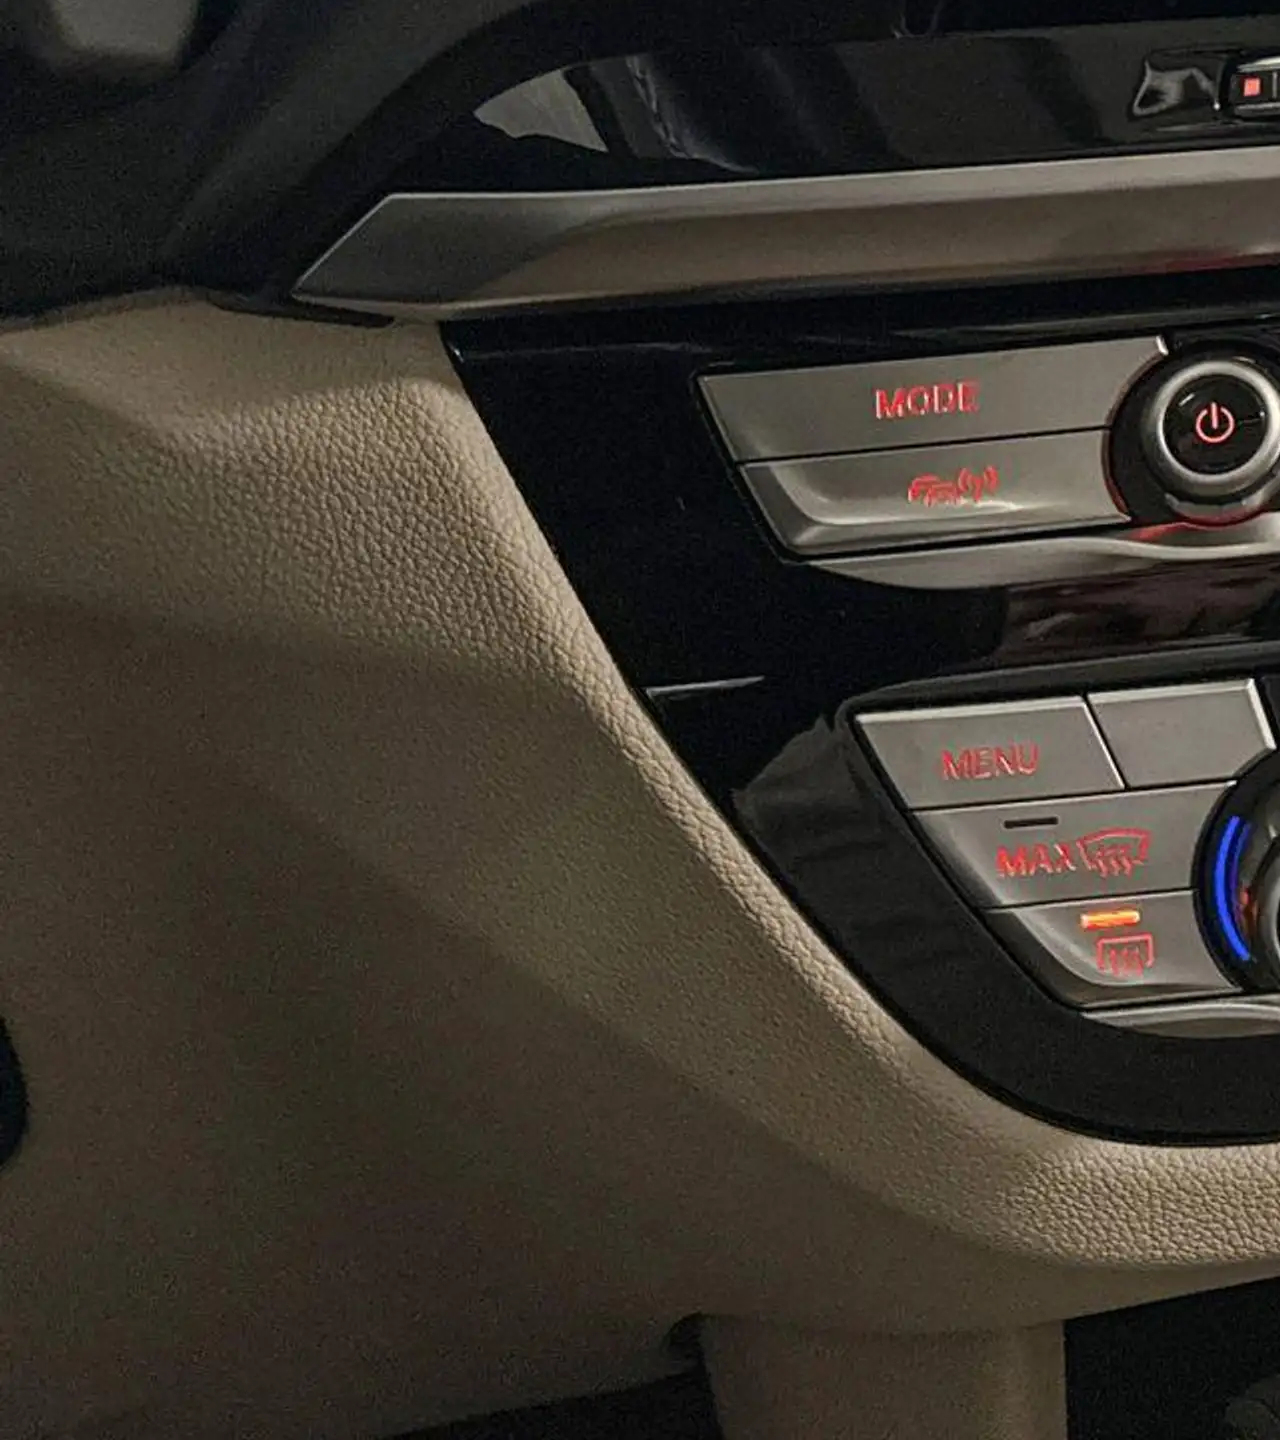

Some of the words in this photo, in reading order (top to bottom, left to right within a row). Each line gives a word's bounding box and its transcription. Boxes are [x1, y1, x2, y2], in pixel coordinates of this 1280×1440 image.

[874, 381, 980, 421] MODE
[940, 740, 1040, 781] MENU
[994, 843, 1076, 878] MAX
